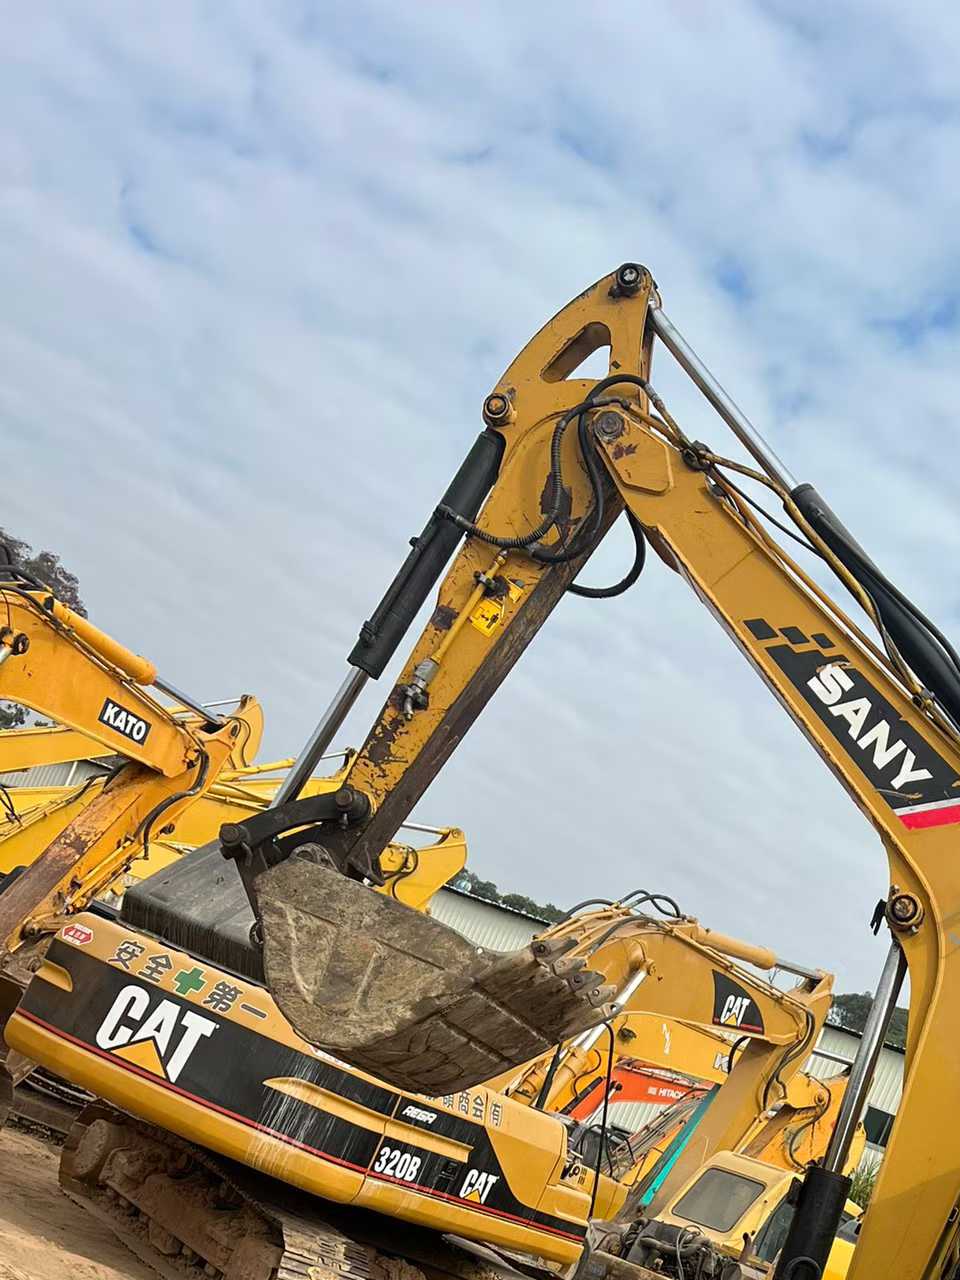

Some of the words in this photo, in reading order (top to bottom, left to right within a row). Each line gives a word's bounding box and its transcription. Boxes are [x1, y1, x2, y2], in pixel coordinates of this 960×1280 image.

[103, 702, 146, 741] KATO
[807, 664, 934, 790] SANY
[720, 994, 751, 1027] CAT
[96, 985, 217, 1083] CAT
[374, 1147, 421, 1182] 320B
[459, 1169, 499, 1204] CAT
